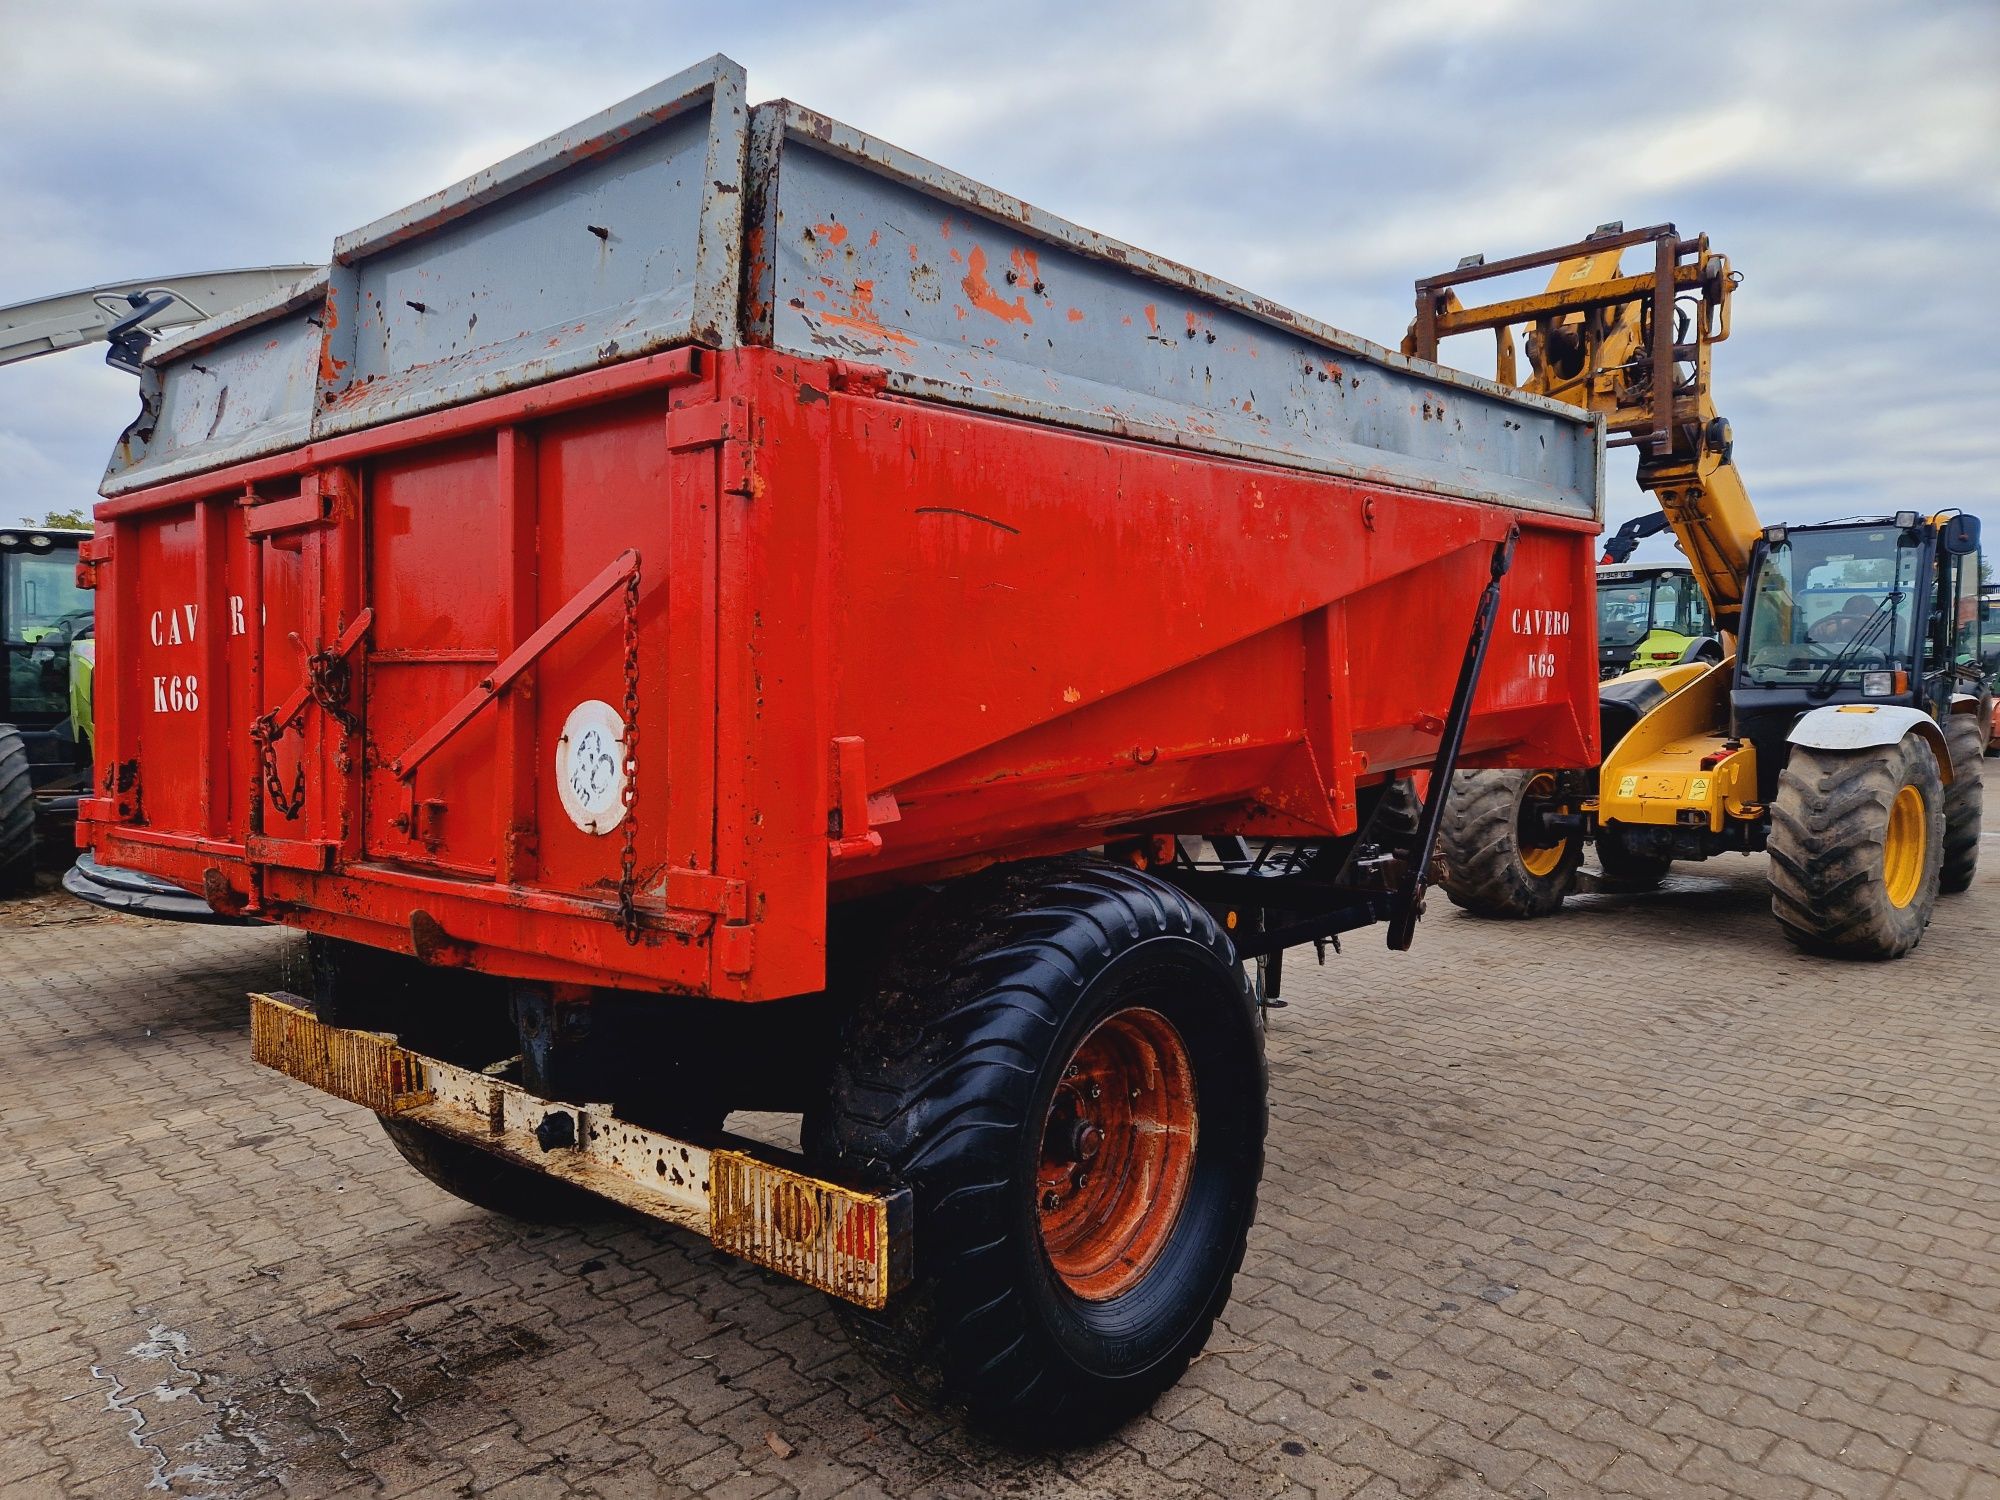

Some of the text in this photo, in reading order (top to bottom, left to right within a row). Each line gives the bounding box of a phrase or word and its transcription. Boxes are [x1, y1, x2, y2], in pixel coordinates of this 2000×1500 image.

[151, 595, 266, 647] CAVR
[1512, 608, 1570, 636] CAVERO
[1528, 653, 1555, 679] K68
[153, 675, 199, 713] K68
